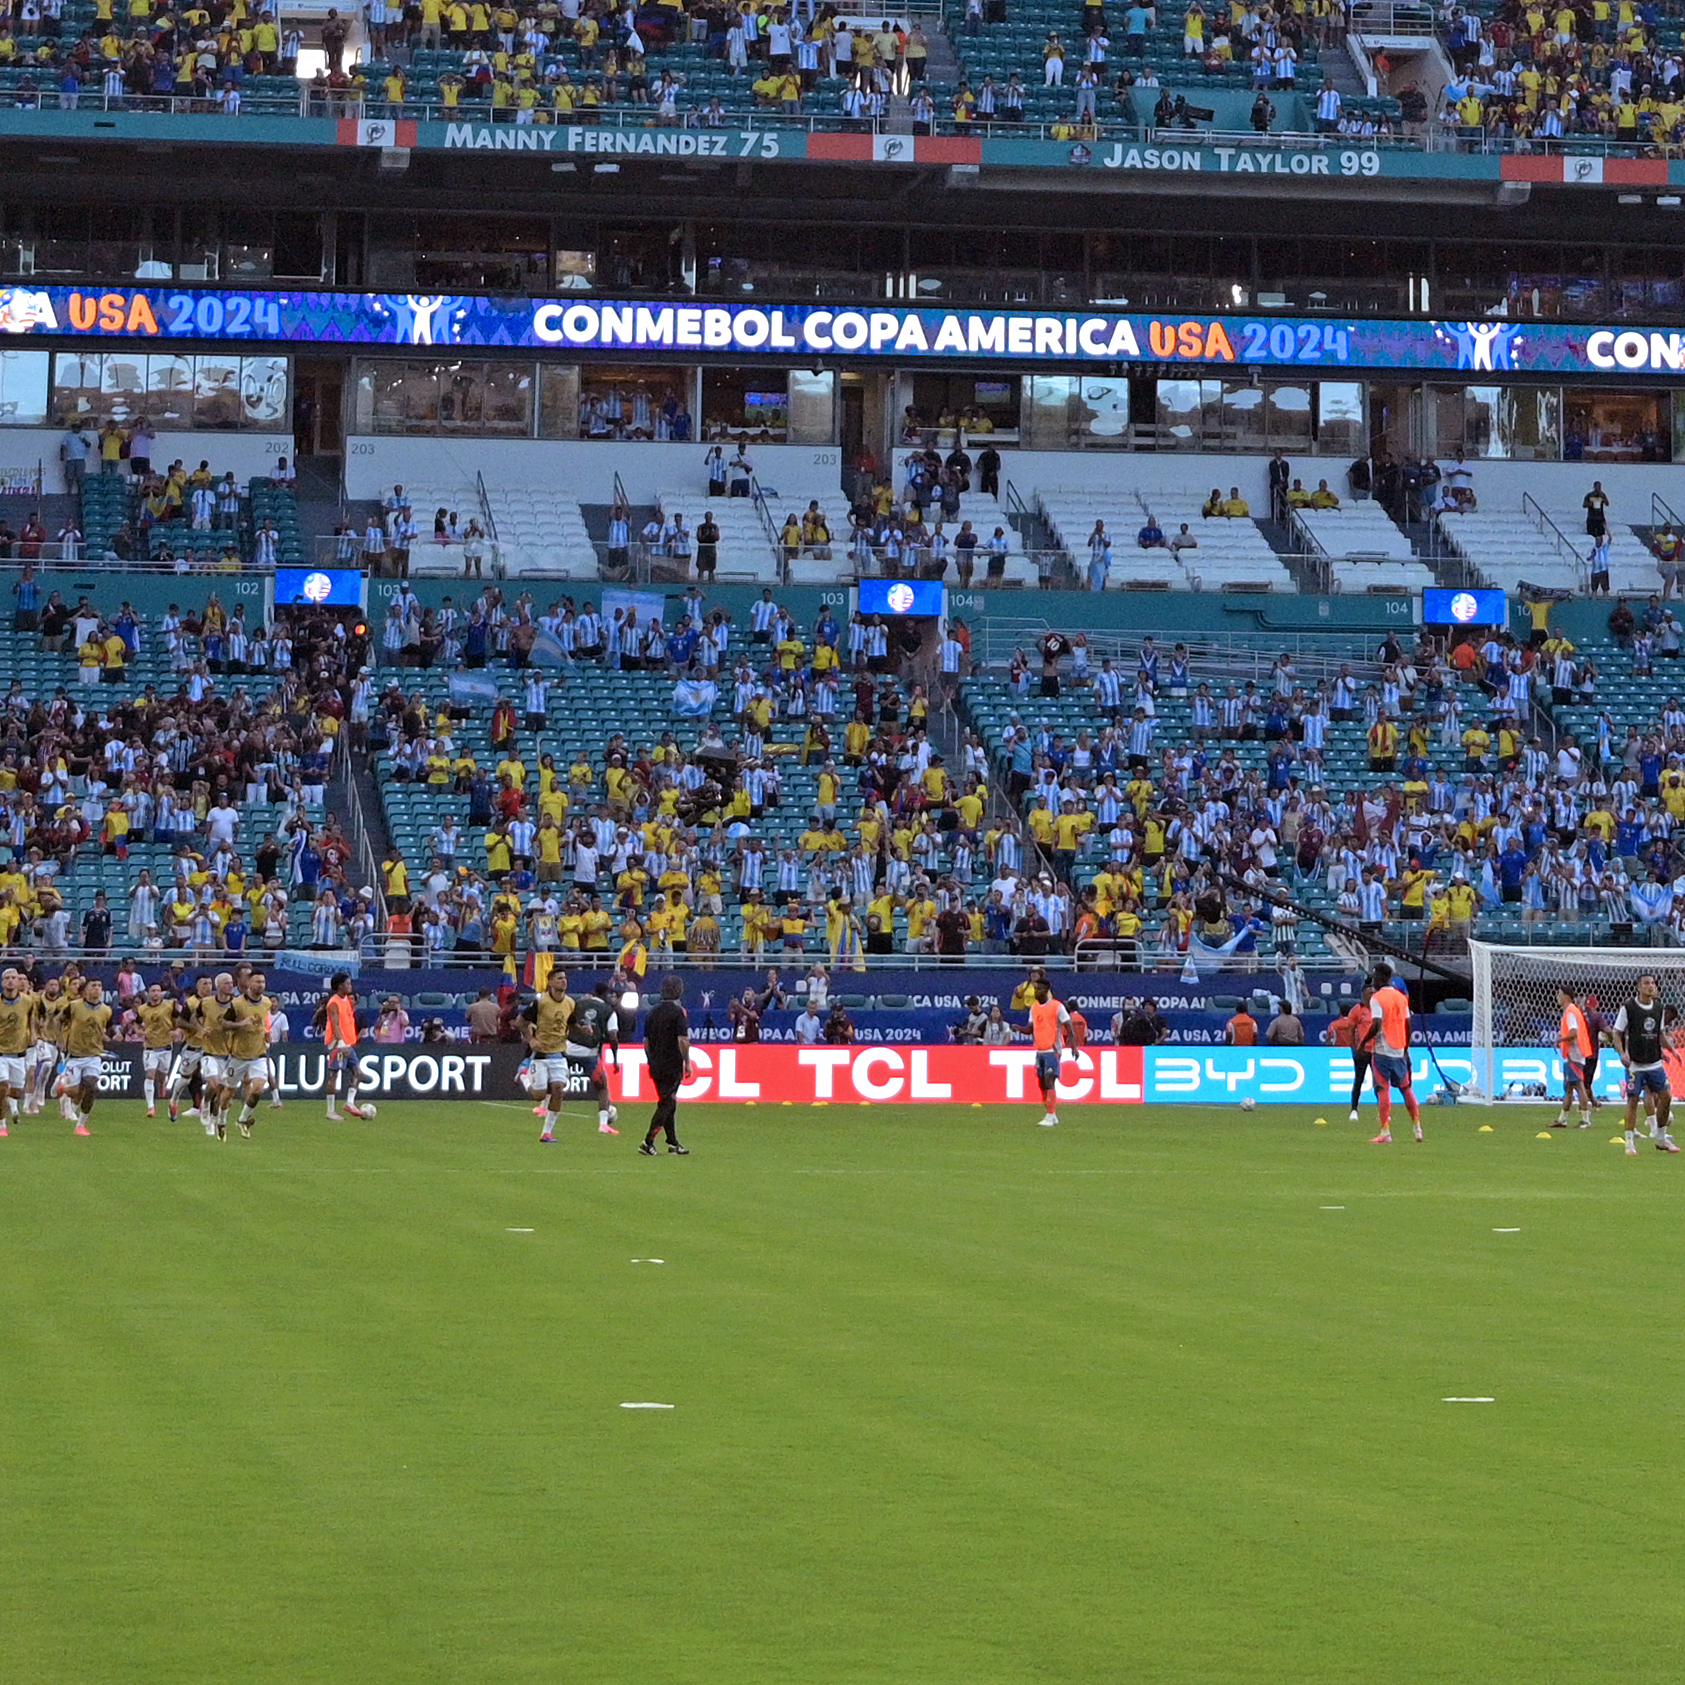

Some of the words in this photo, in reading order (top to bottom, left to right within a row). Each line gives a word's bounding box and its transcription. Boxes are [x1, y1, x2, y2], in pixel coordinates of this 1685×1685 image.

[444, 124, 556, 153] MANNY
[567, 126, 729, 157] FERNANDEZ
[739, 132, 779, 157] 75
[1104, 144, 1200, 171] JASON
[1212, 147, 1329, 175] TAYLOR
[1339, 151, 1380, 176] 99
[68, 295, 158, 334] USA
[167, 295, 281, 336] 2024
[533, 304, 793, 349] CONMEBOL
[804, 311, 925, 350] COPA
[934, 316, 1140, 357] AMERICA
[1149, 320, 1235, 361] USA
[1243, 322, 1348, 362] 2024
[265, 442, 289, 454] 202
[351, 443, 375, 455] 203
[813, 453, 838, 466] 203
[235, 582, 259, 595] 102
[378, 584, 401, 597] 103
[821, 592, 844, 605] 103
[950, 594, 974, 606] 104
[1386, 602, 1408, 614] 104
[935, 996, 961, 1007] USA
[855, 1028, 883, 1041] USA
[886, 1027, 921, 1041] 2024
[1183, 1029, 1211, 1041] USA
[359, 1055, 491, 1092] SPORT
[604, 1048, 760, 1099] TCL
[798, 1047, 951, 1100] TCL
[990, 1047, 1140, 1099] TCL
[1155, 1058, 1304, 1091] BYD
